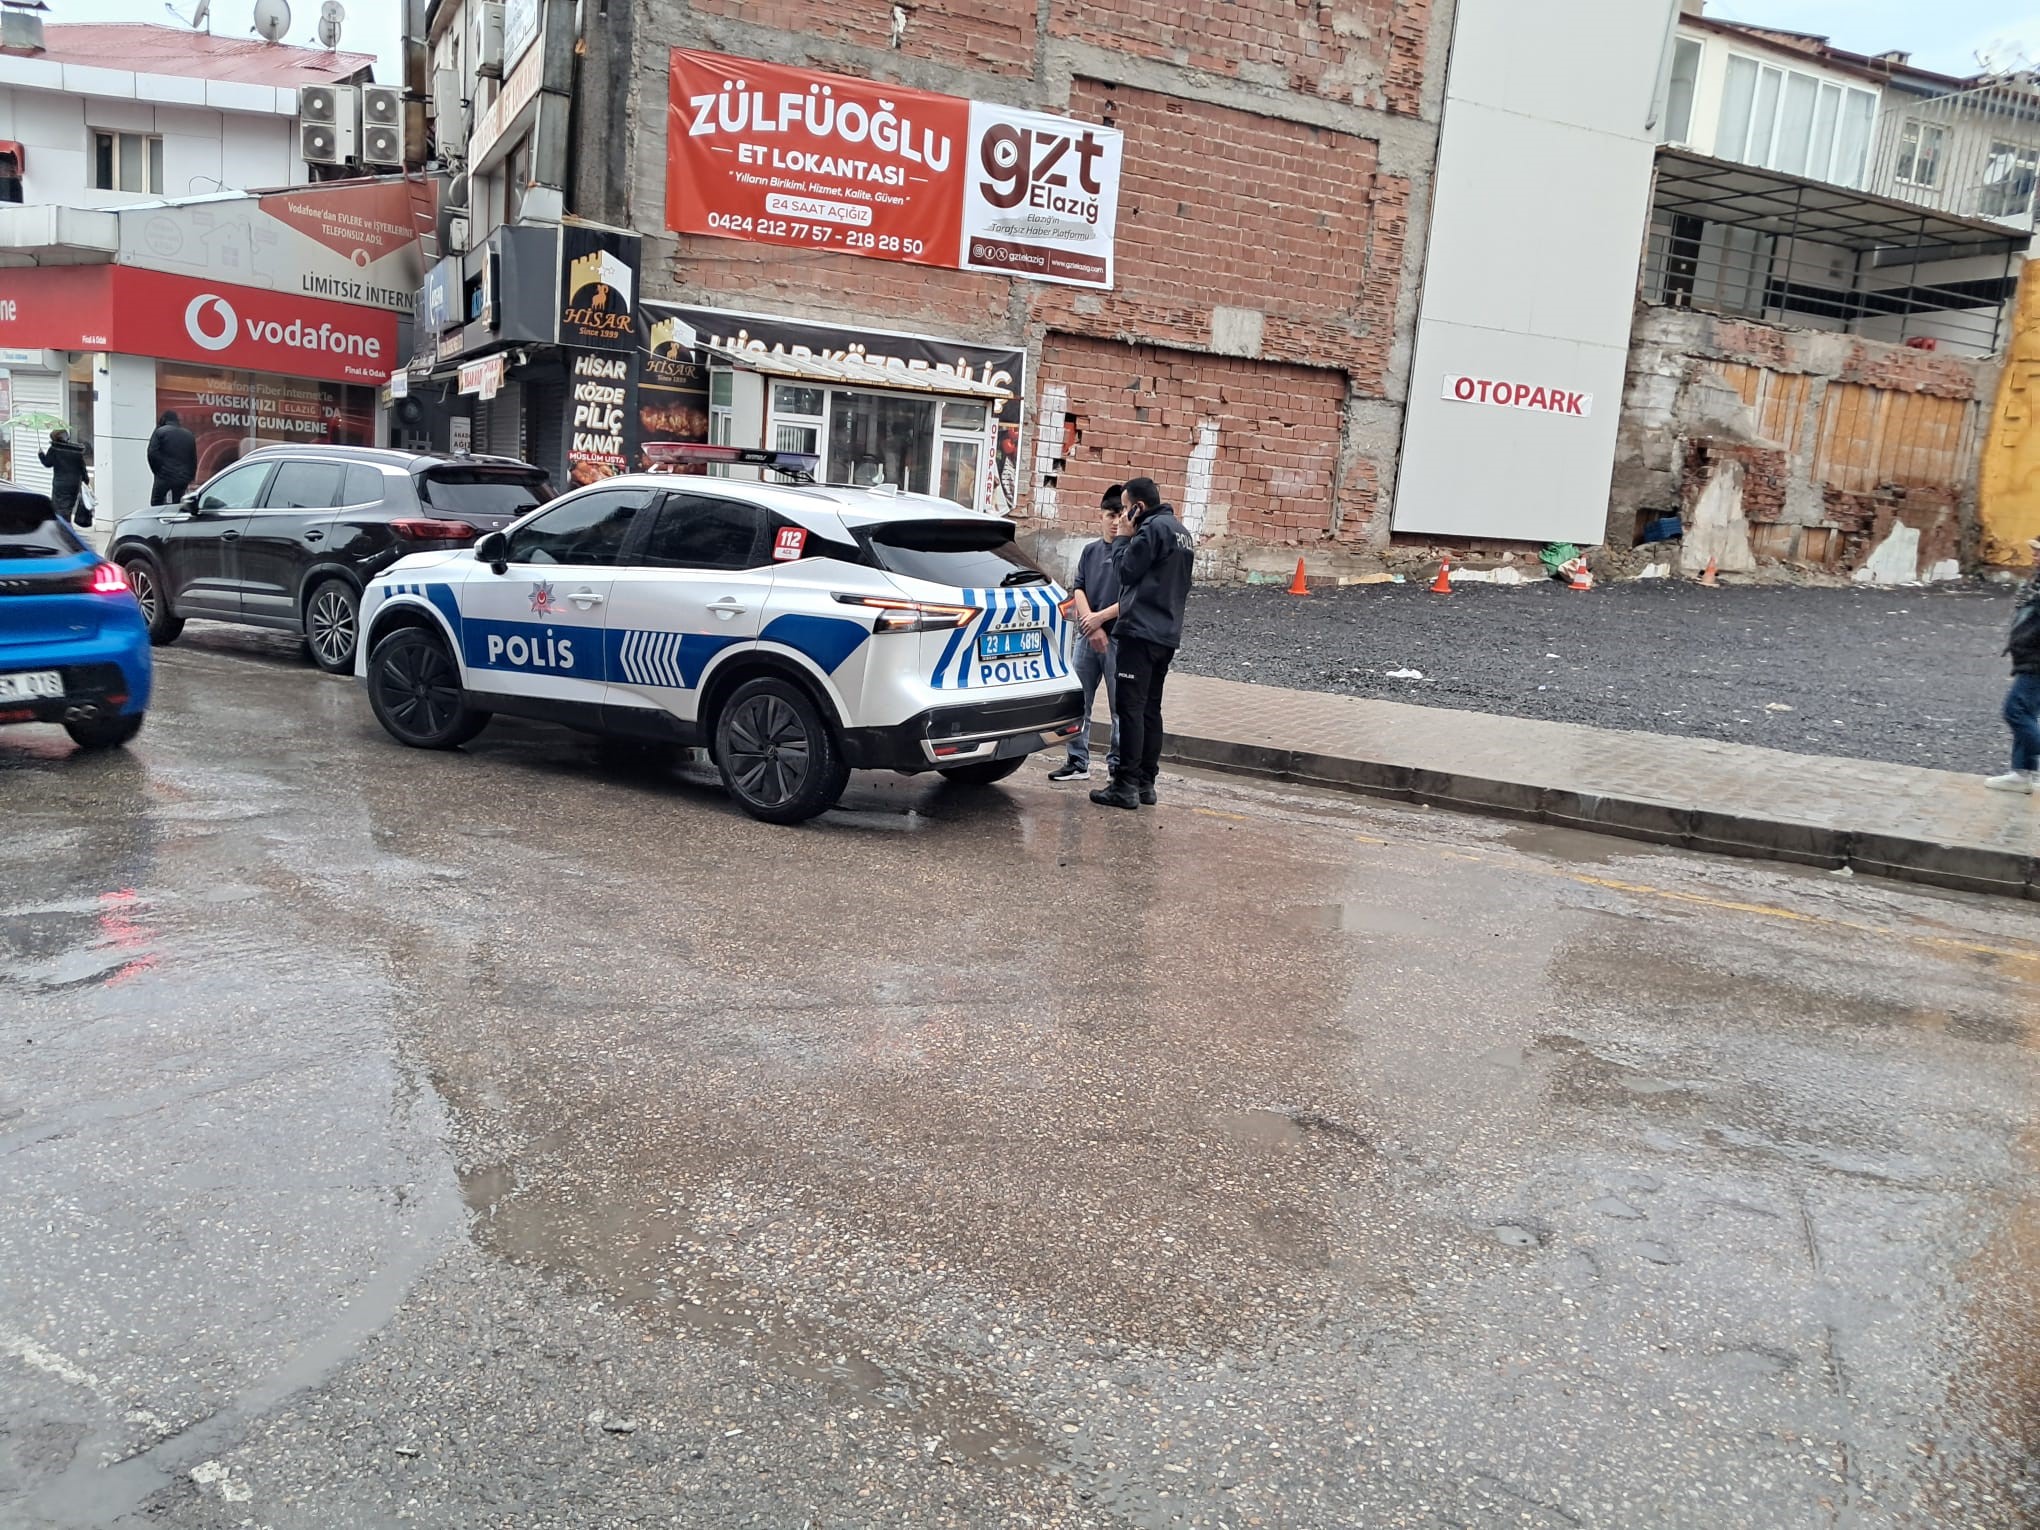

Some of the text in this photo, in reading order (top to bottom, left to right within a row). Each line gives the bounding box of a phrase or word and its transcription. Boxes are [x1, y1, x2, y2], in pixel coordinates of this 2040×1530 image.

[688, 79, 951, 172] ZÜLFÜOĞLU
[738, 143, 904, 186] ET LOKANTASI
[980, 123, 1104, 209] gzt
[772, 198, 868, 221] 24 SAAT AÇIĞIZ
[1029, 184, 1099, 224] Elazığ
[338, 213, 363, 226] EVLERE
[363, 221, 373, 229] ve
[991, 223, 1090, 241] Tarafsız Haber Platformu
[322, 224, 383, 246] TELEFONSUZ ADSL
[708, 212, 753, 232] 0424
[757, 219, 786, 236] 212
[790, 222, 809, 238] 77
[812, 225, 833, 242] 57
[846, 230, 874, 249] 218
[878, 234, 900, 251] 28
[903, 238, 923, 255] 50
[302, 271, 362, 300] LİMİTSİZ
[563, 308, 635, 334] HİSAR
[579, 327, 599, 337] Since
[246, 318, 381, 359] vodafone
[345, 366, 362, 376] Final
[368, 368, 386, 378] Odak
[574, 353, 628, 381] HİSAR
[645, 360, 700, 379] HİSAR
[206, 378, 256, 393] Vodafone
[256, 384, 281, 396] Fiber
[574, 381, 626, 406] KÖZDE
[1455, 377, 1585, 415] OTOPARK
[196, 392, 250, 409] YÜKSEK
[250, 398, 276, 412] HIZI
[212, 412, 328, 434] ÇOK UYGUNA DENE
[573, 402, 625, 436] PİLİÇ
[572, 432, 624, 456] KANAT
[569, 450, 625, 465] MÜSLÜM USTA
[985, 424, 997, 504] OTOPARK
[781, 530, 802, 547] 112
[487, 628, 575, 669] POLİS
[986, 632, 1040, 654] 23 A 4819
